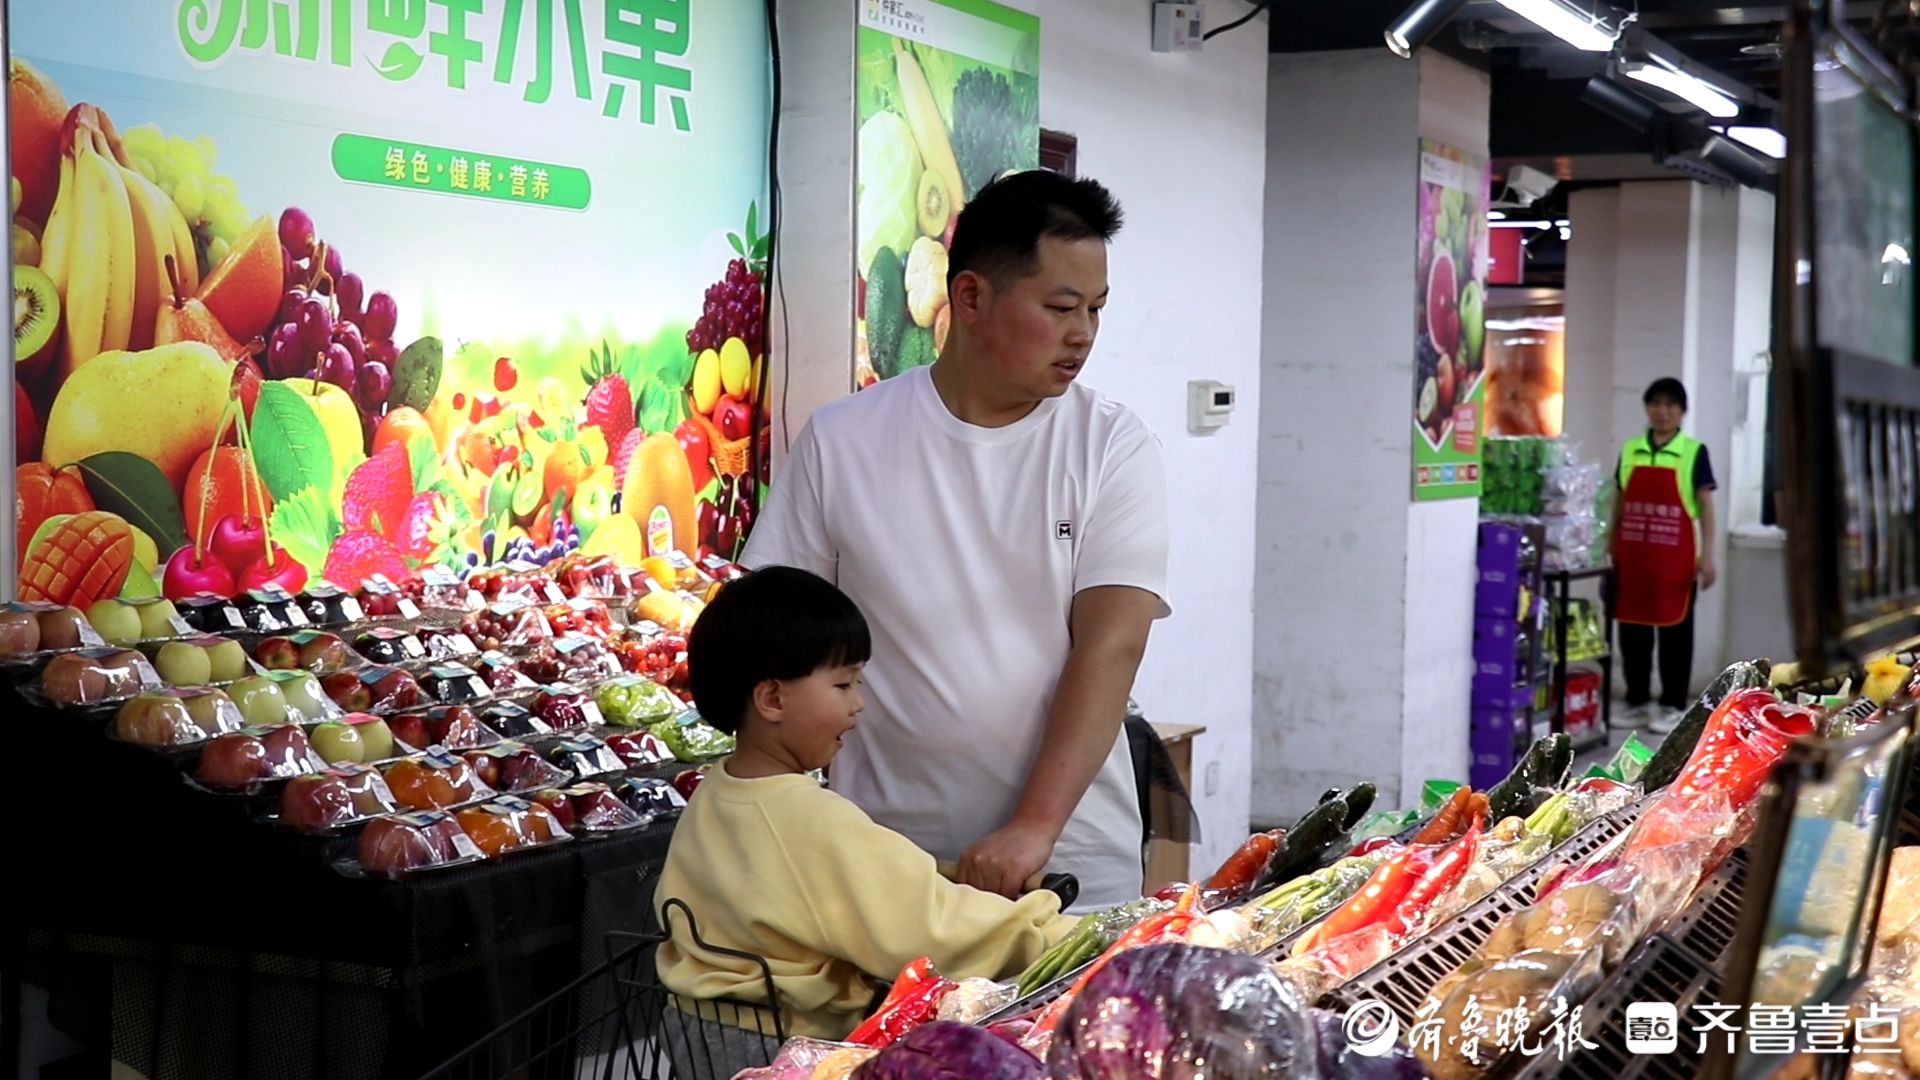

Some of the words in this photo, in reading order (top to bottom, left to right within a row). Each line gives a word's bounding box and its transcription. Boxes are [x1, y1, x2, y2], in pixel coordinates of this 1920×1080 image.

[385, 146, 550, 200] 绿色·健康·营养
